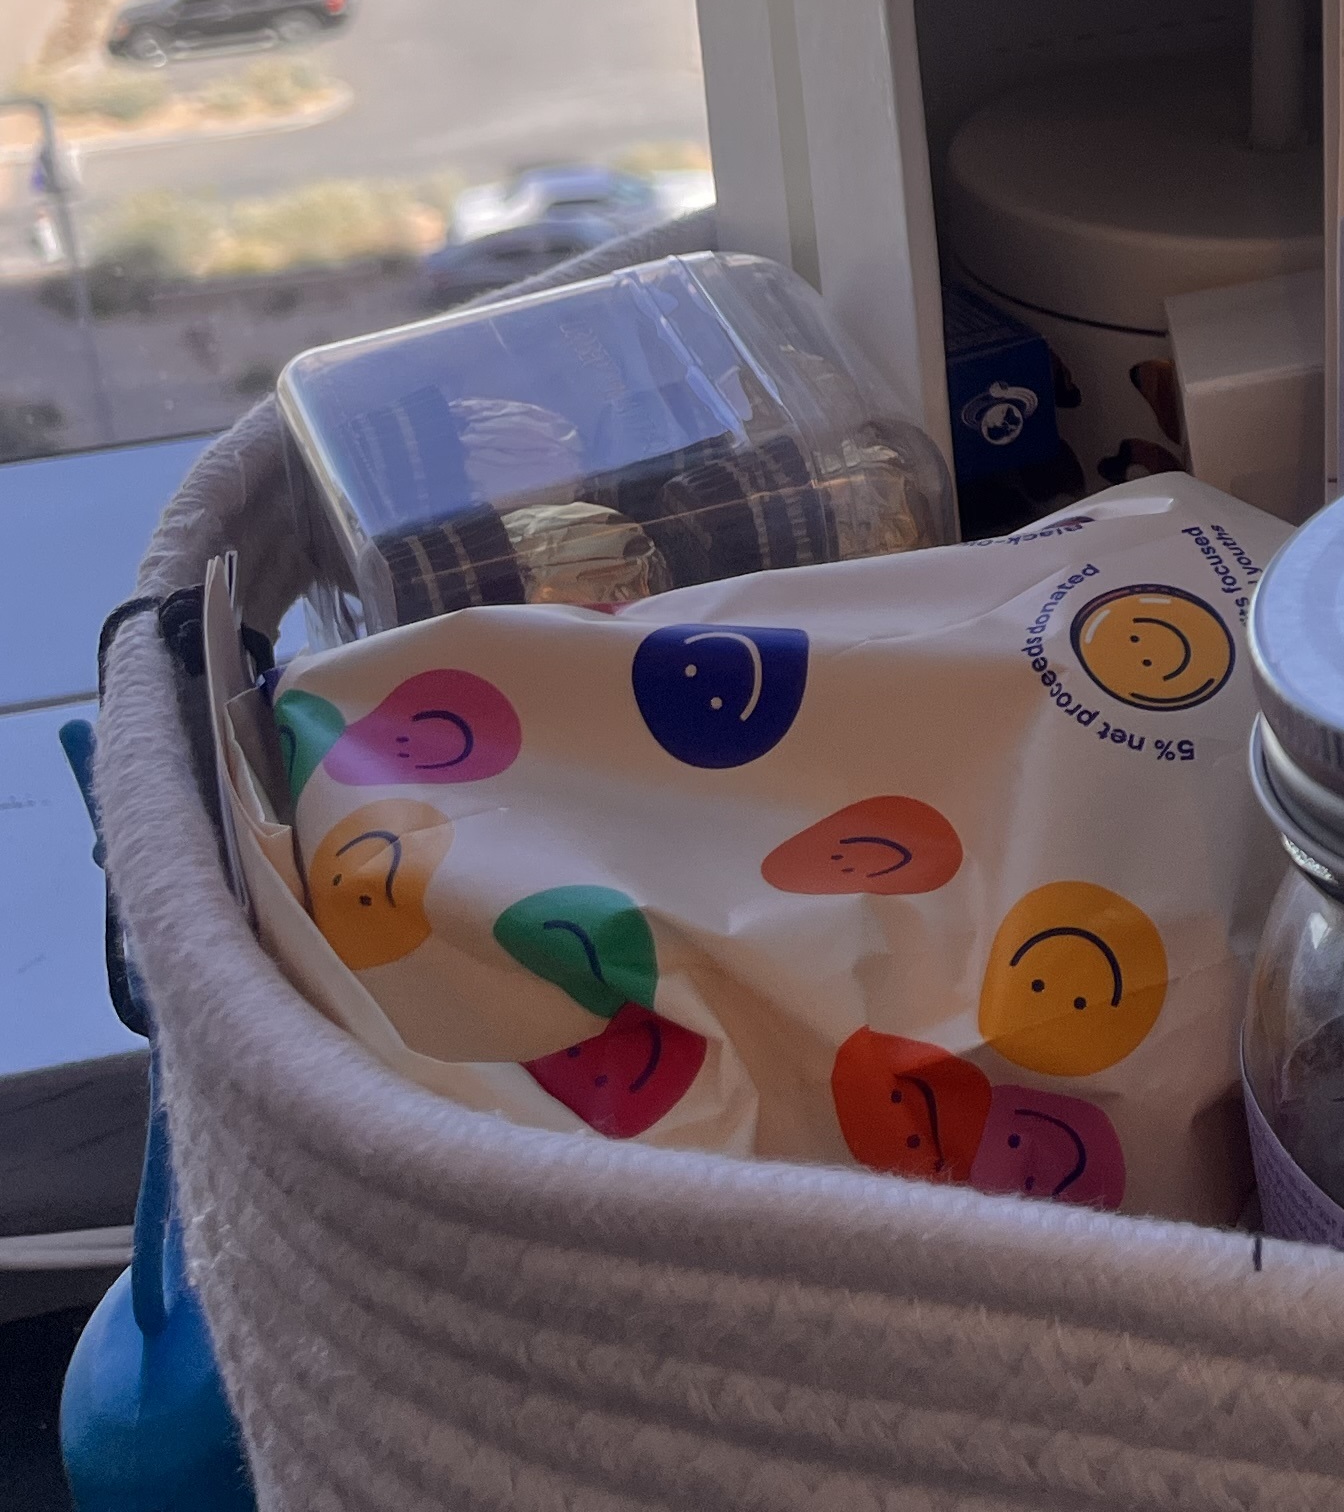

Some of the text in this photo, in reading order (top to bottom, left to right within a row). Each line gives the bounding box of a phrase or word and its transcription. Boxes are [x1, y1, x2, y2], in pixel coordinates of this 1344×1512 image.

[1181, 525, 1244, 595] focused
[1210, 523, 1263, 577] youths
[1025, 562, 1102, 636] donated
[1019, 637, 1102, 729] proceeds
[1095, 719, 1197, 763] 5% net
